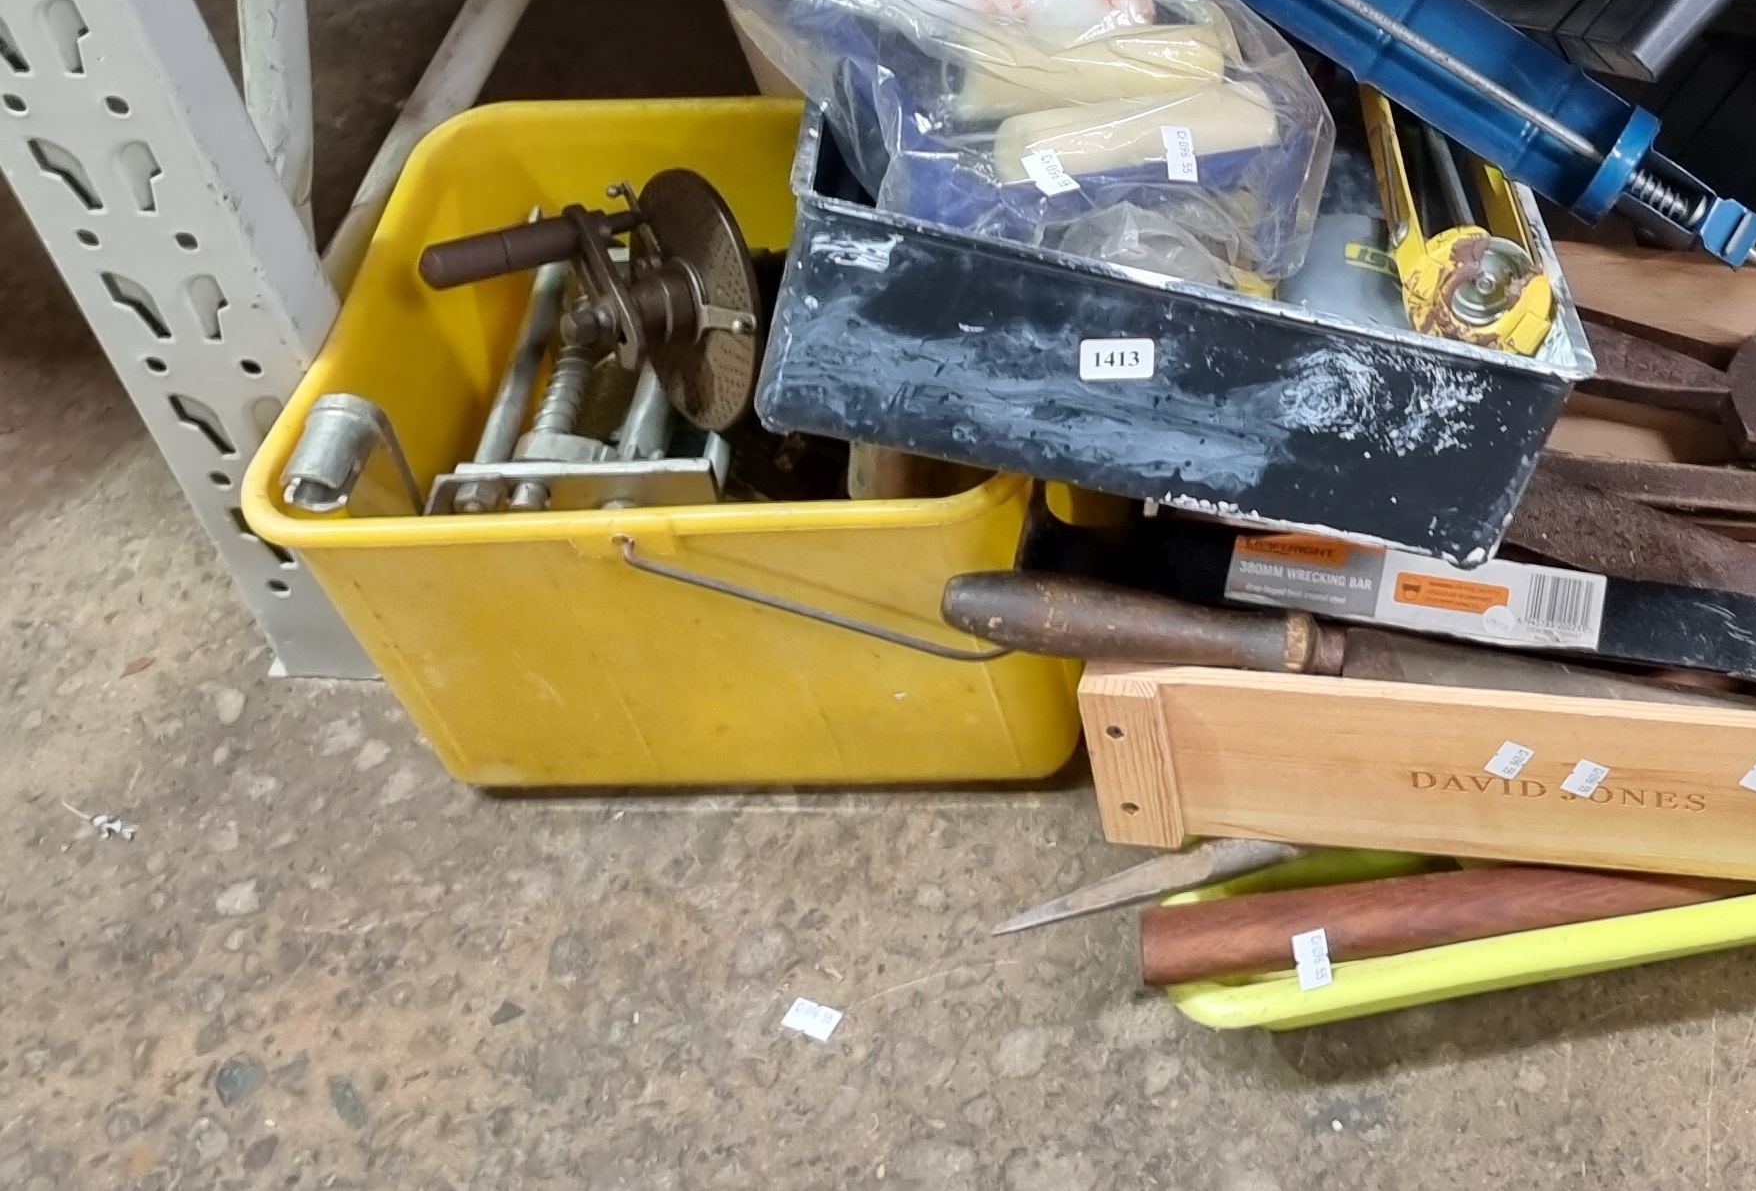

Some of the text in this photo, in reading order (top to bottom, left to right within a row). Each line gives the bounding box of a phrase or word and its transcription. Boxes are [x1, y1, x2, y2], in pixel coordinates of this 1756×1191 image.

[1093, 350, 1140, 368] 1413
[1286, 566, 1347, 588] WRECKING
[1349, 575, 1374, 591] BAR
[1408, 770, 1547, 798] DAVID
